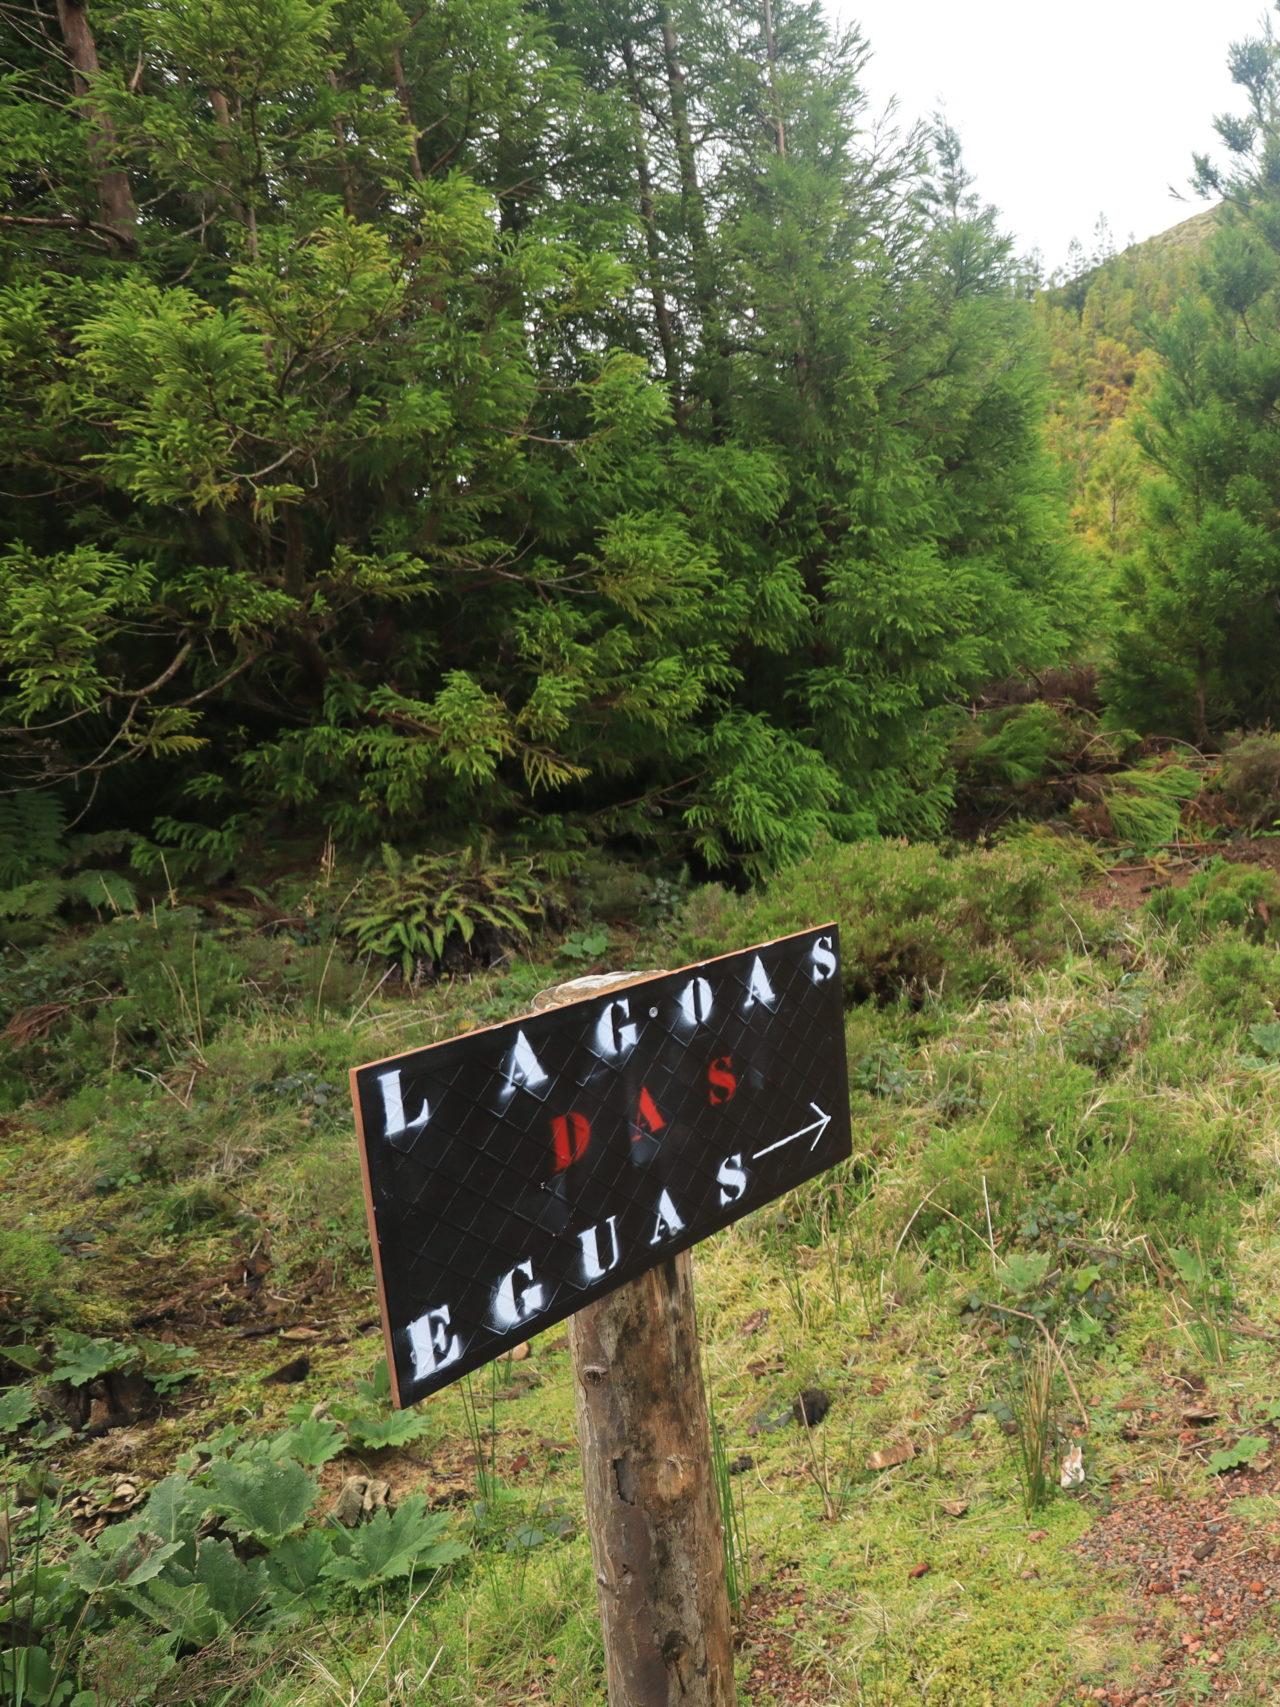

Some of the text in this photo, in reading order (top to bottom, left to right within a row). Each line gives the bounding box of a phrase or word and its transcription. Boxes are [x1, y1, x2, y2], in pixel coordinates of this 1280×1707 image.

[378, 936, 837, 1137] LAGOAS
[550, 1056, 737, 1172] DAS
[406, 1153, 748, 1381] EGUAS
